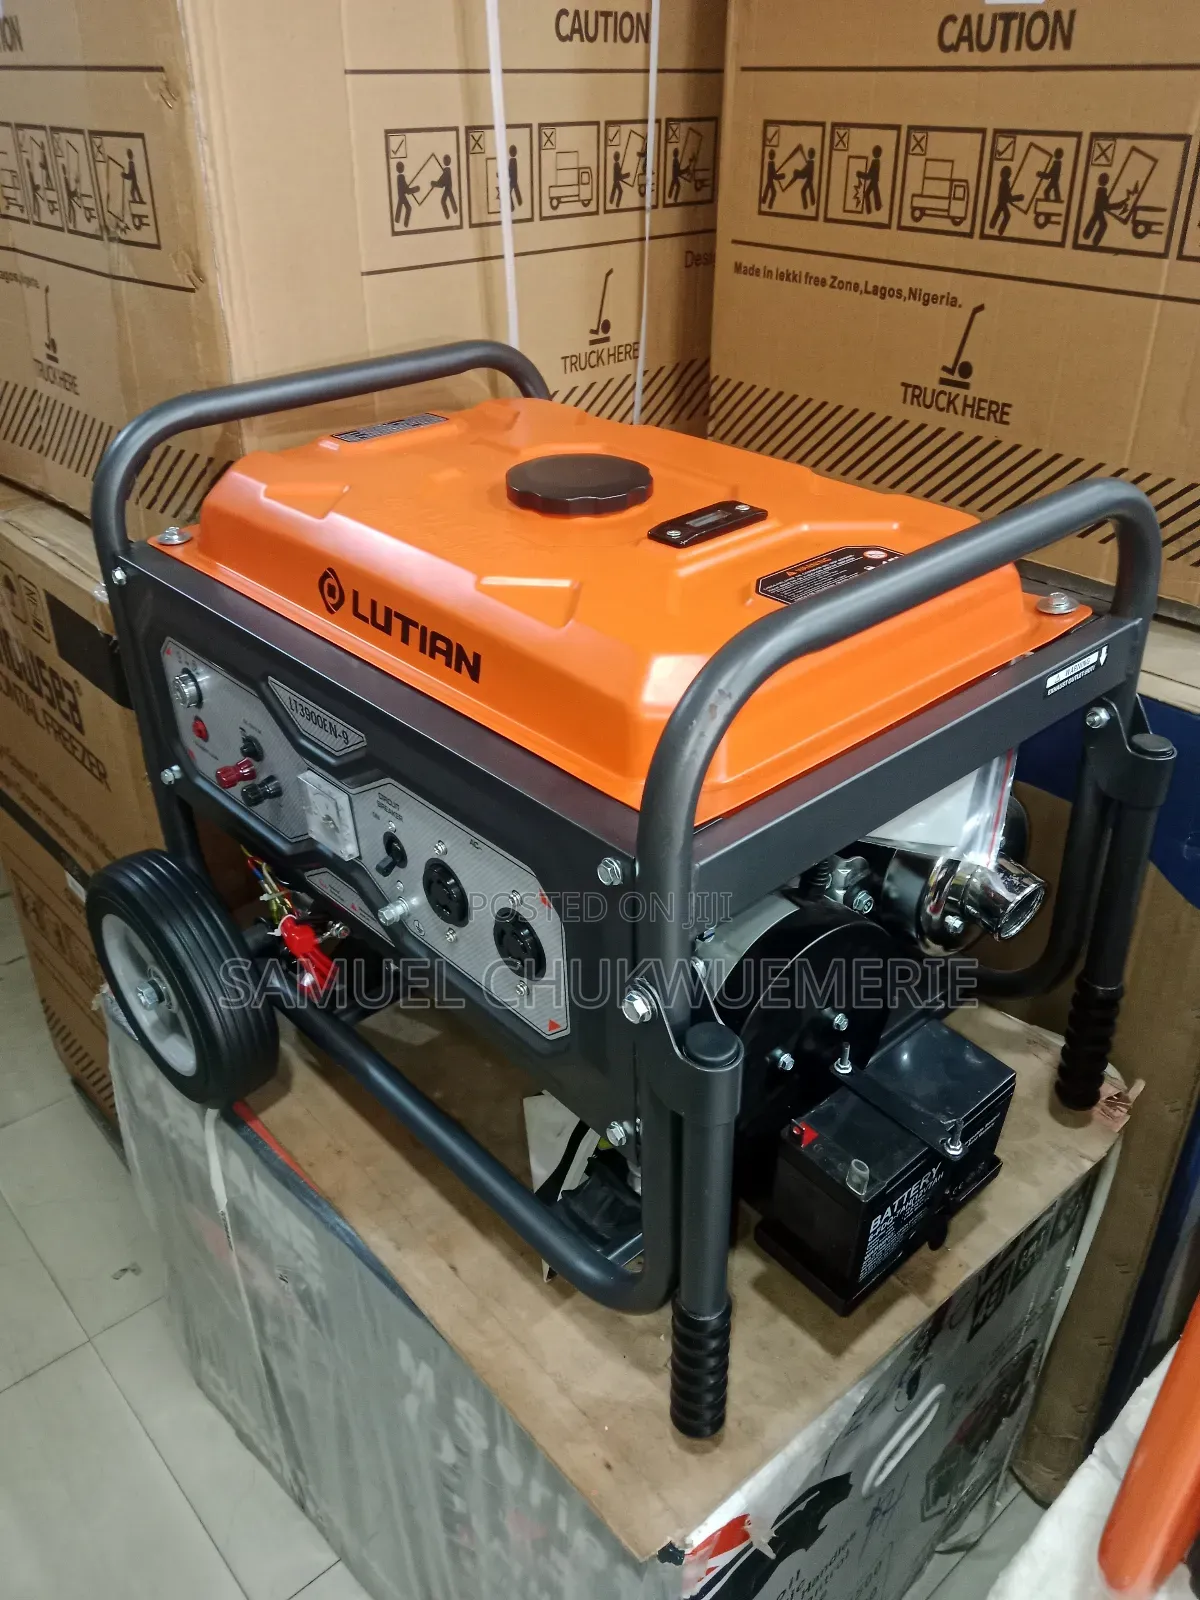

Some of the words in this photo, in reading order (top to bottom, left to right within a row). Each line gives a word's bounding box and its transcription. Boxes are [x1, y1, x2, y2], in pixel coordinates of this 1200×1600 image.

[555, 8, 650, 43] CAUTION
[938, 9, 1076, 53] CAUTION
[733, 261, 761, 278] Made
[762, 265, 773, 280] in
[804, 271, 827, 288] free
[561, 347, 606, 374] TRUCK
[607, 342, 640, 367] HERE
[900, 381, 960, 415] TRUCK
[961, 394, 1013, 426] HERE
[352, 588, 482, 684] LUTIAN
[288, 696, 349, 746] LT3900EN-9
[869, 1161, 942, 1234] BATTERY
